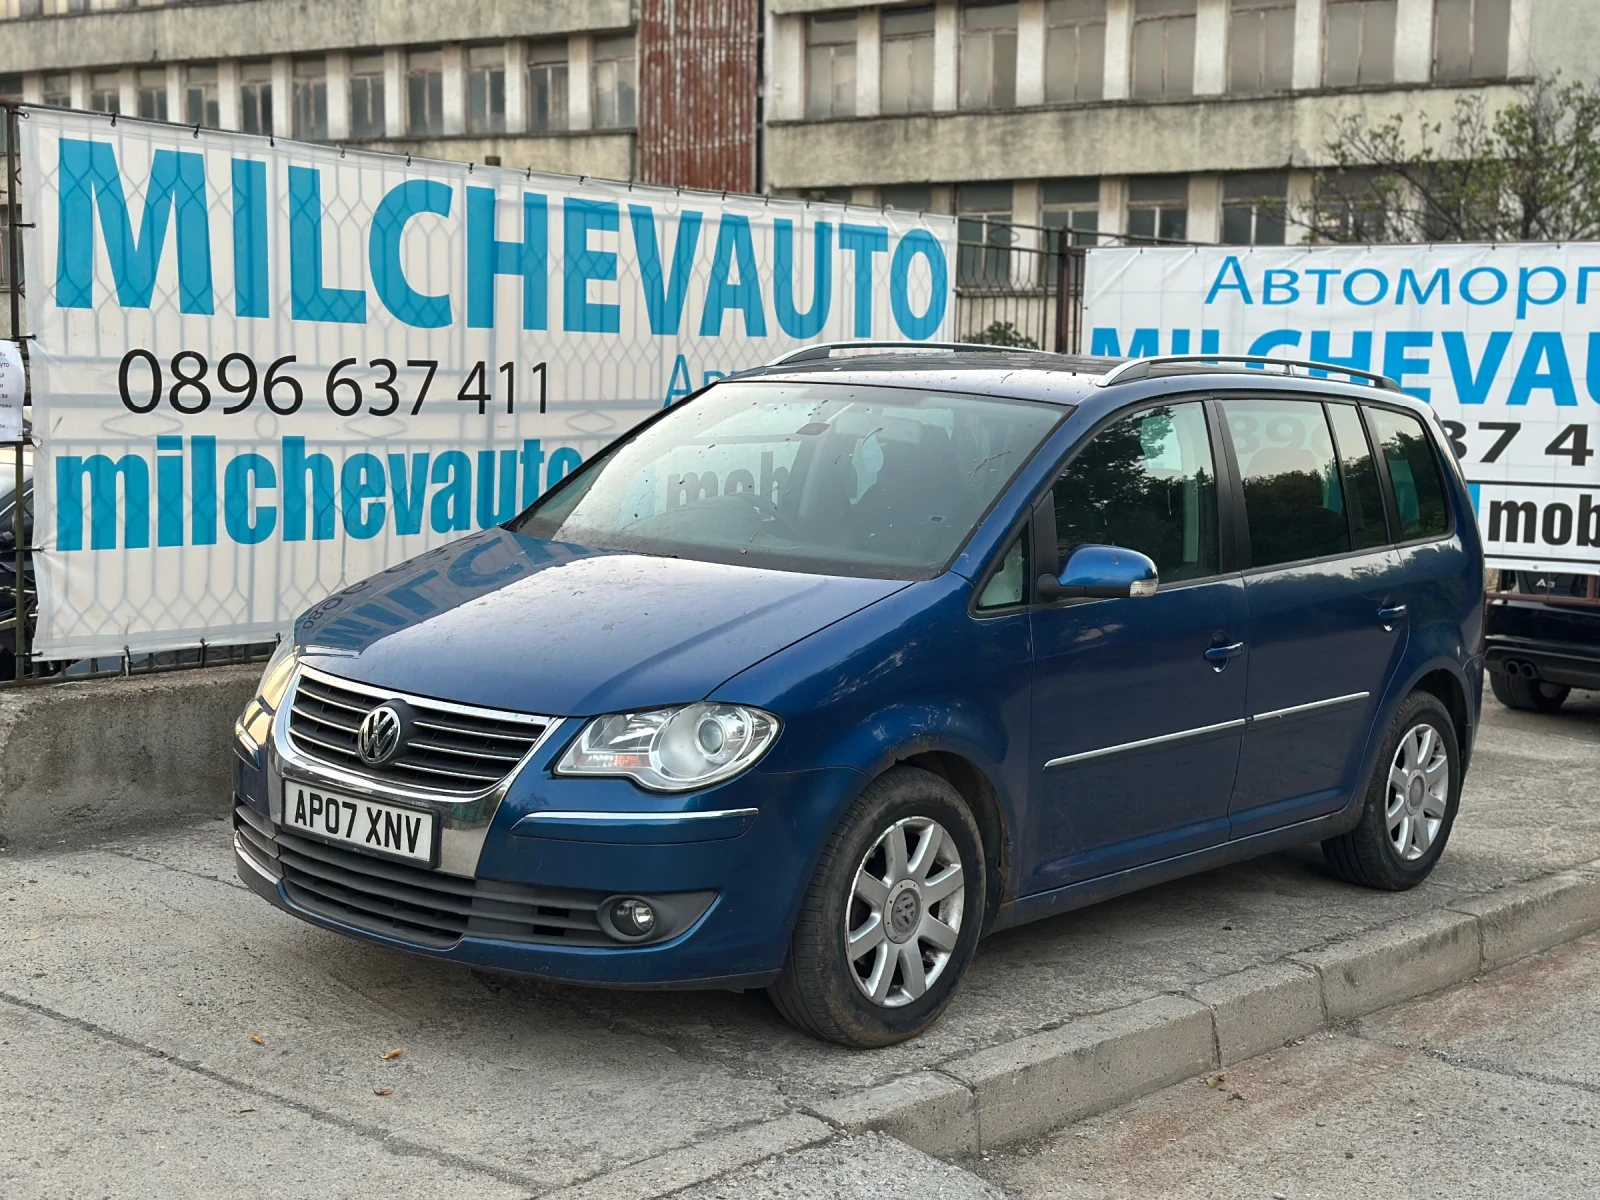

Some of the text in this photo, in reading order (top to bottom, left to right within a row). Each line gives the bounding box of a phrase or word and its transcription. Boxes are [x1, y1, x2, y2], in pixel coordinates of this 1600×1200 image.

[56, 138, 948, 341] MILCHEVAUTO
[117, 349, 548, 417] 0896 637 411
[1544, 424, 1594, 466] 4
[1488, 494, 1600, 549] mob
[294, 789, 422, 854] AP07 XNV
